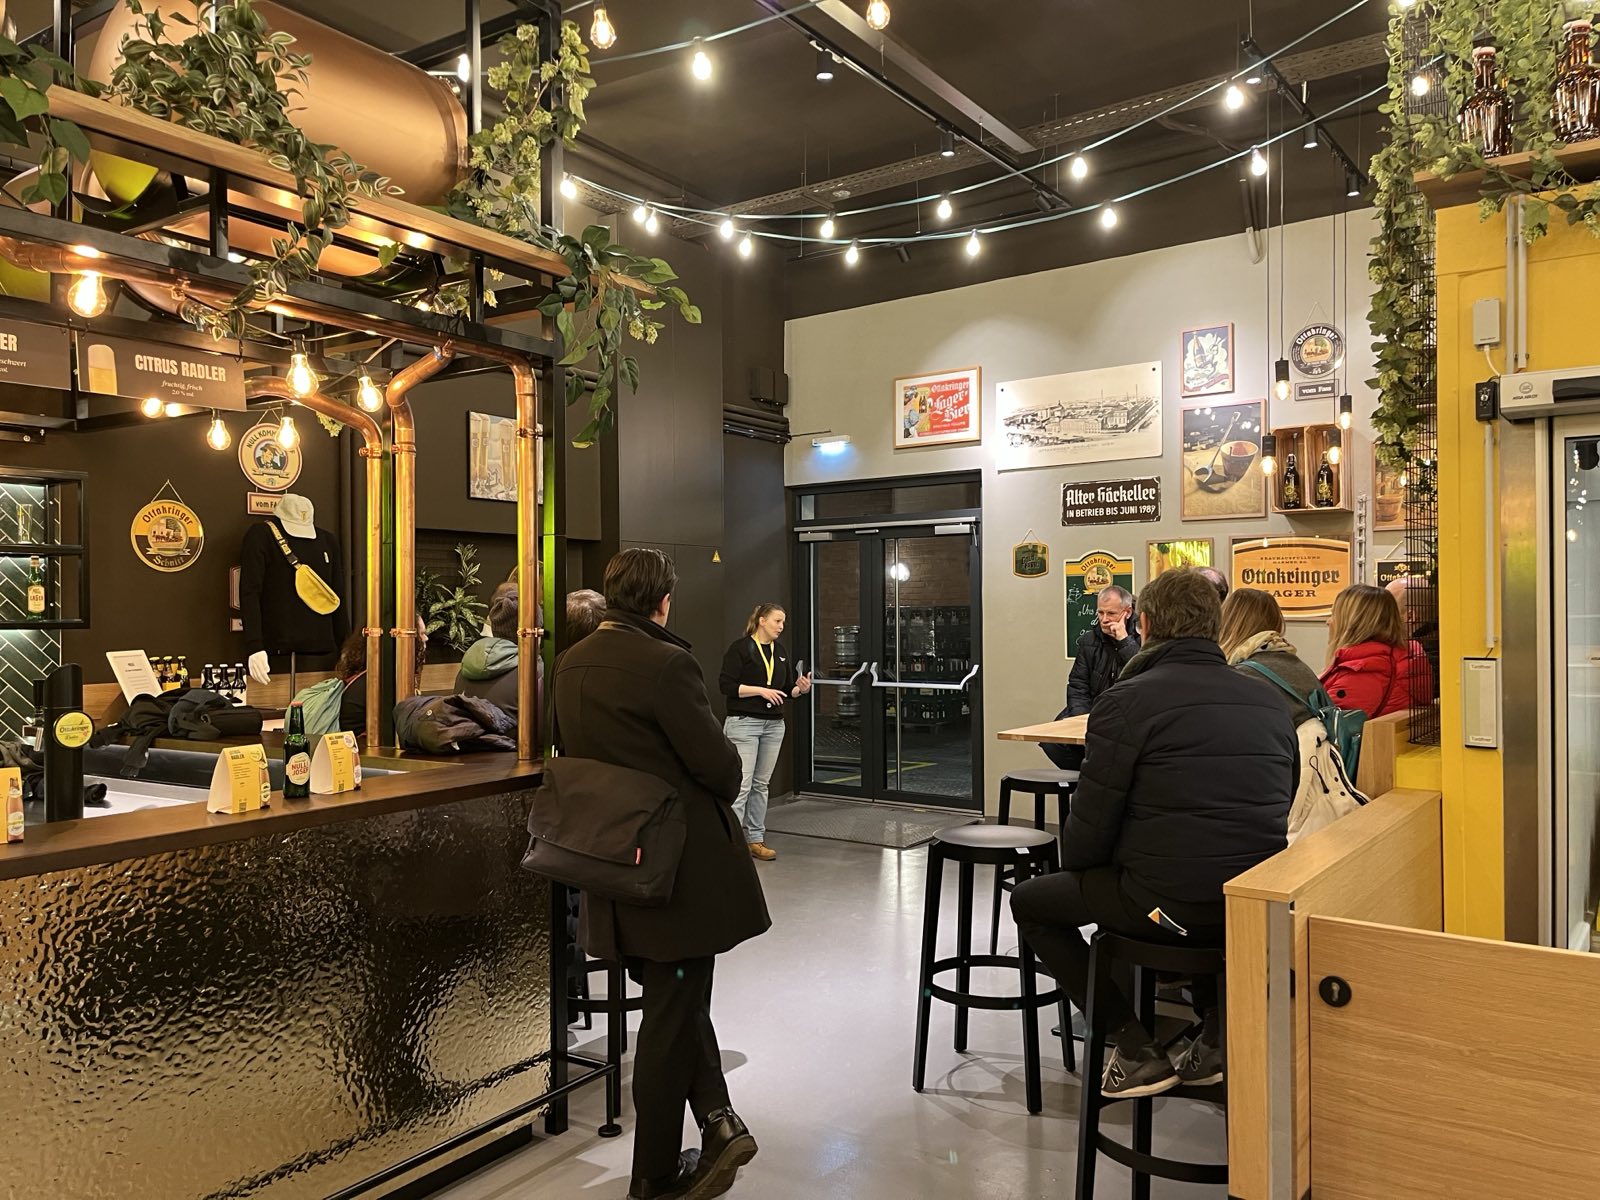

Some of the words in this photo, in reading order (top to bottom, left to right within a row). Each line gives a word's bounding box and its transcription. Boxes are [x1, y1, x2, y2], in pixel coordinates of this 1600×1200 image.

[135, 354, 179, 376] CITRUS
[181, 361, 226, 382] RADLER
[246, 433, 260, 449] NULL
[1066, 489, 1095, 507] Alter
[1066, 509, 1074, 518] IN
[1075, 507, 1105, 518] BETRIEB
[1105, 506, 1119, 516] BIS
[1119, 505, 1138, 515] JUNI
[1241, 567, 1341, 588] Ottakringer
[1262, 589, 1317, 598] AGER
